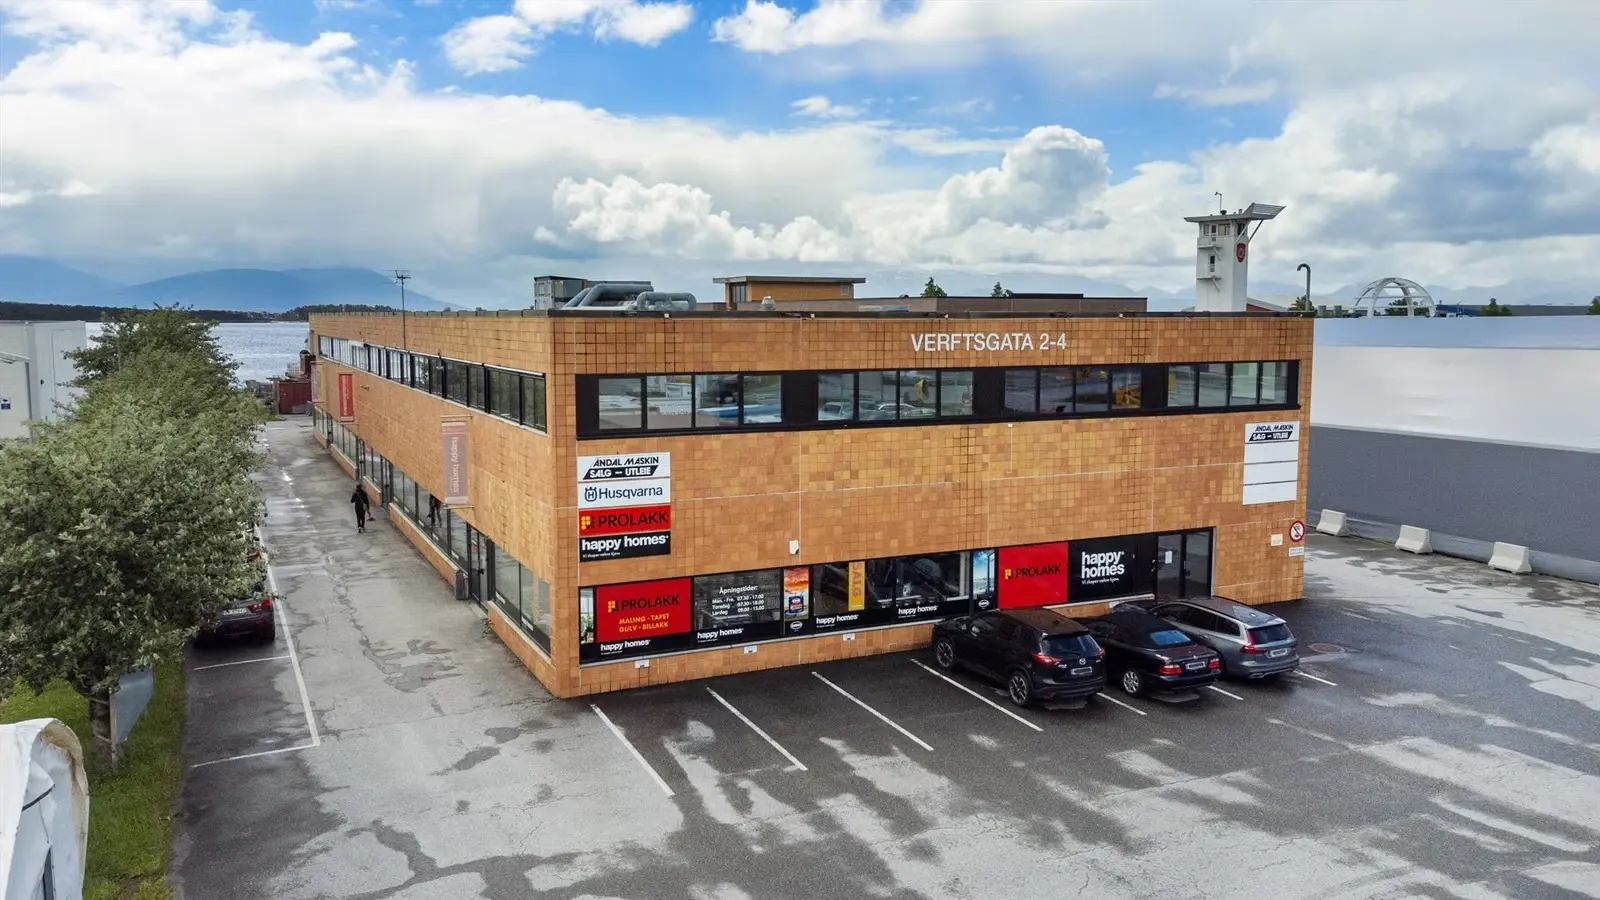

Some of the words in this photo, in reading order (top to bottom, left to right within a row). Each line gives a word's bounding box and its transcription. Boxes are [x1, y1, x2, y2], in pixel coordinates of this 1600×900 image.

[911, 333, 1034, 351] VERFTSGATA
[1039, 333, 1067, 350] 2-4
[624, 456, 659, 465] MASKIN
[452, 463, 460, 493] homes
[589, 469, 612, 478] SALG
[625, 467, 651, 476] UTLEIE
[599, 487, 663, 499] Husqvarna
[598, 512, 668, 528] PROLAKK
[582, 538, 621, 551] happy
[624, 535, 666, 547] homes
[1082, 551, 1121, 566] happy
[1016, 565, 1060, 578] PROLAKK
[1082, 564, 1124, 578] homes
[621, 595, 680, 610] PROLAKK
[619, 616, 646, 624] MALING
[642, 622, 668, 630] BILLAKK
[697, 631, 718, 639] happy
[720, 628, 742, 636] homes
[600, 642, 623, 651] happy
[624, 640, 649, 648] homes
